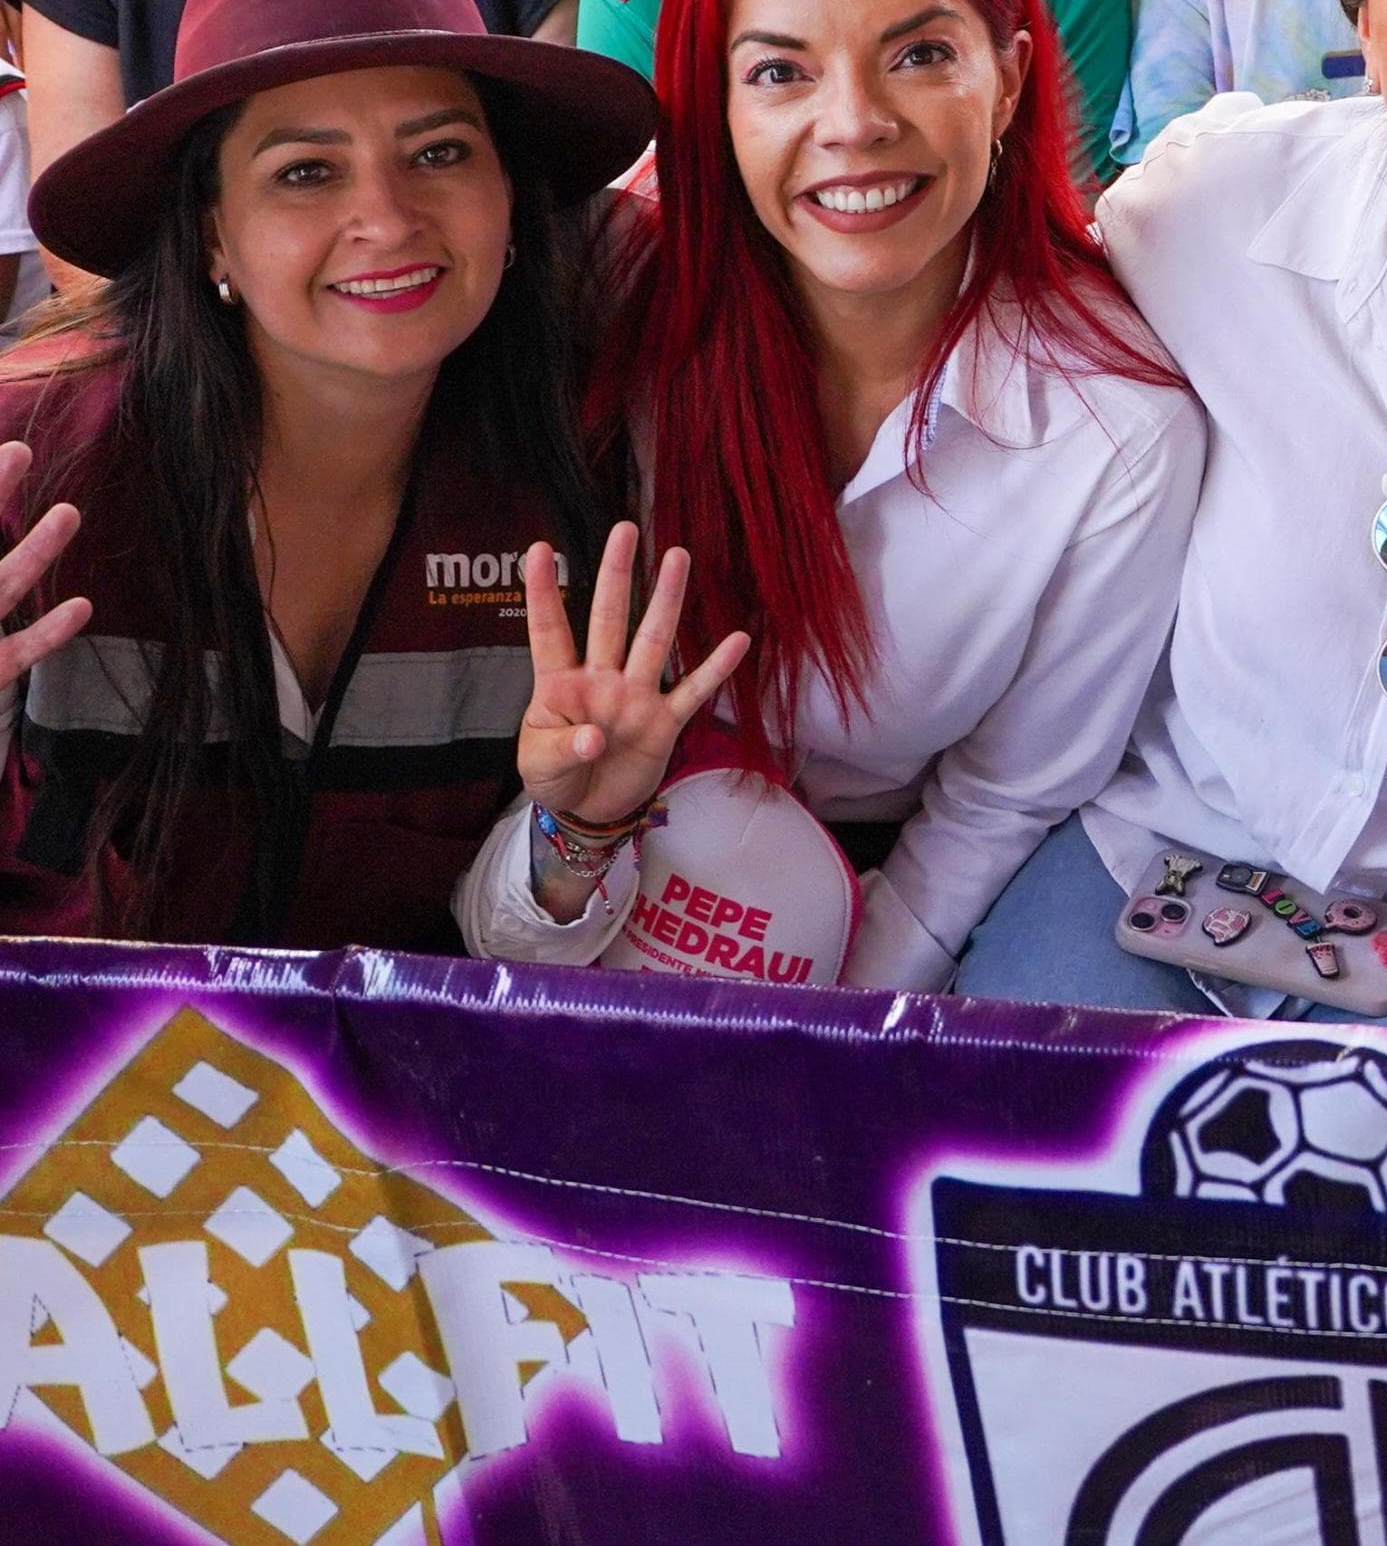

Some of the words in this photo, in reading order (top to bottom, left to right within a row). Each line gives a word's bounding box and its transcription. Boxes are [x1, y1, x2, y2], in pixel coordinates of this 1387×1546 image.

[428, 590, 447, 605] La
[452, 590, 522, 607] esperanza
[661, 873, 773, 942] PEPE
[1262, 888, 1323, 937] LOVE
[627, 929, 693, 976] PRESIDENTE
[631, 893, 814, 984] HEDRAUI
[1016, 1244, 1148, 1315] CLUB
